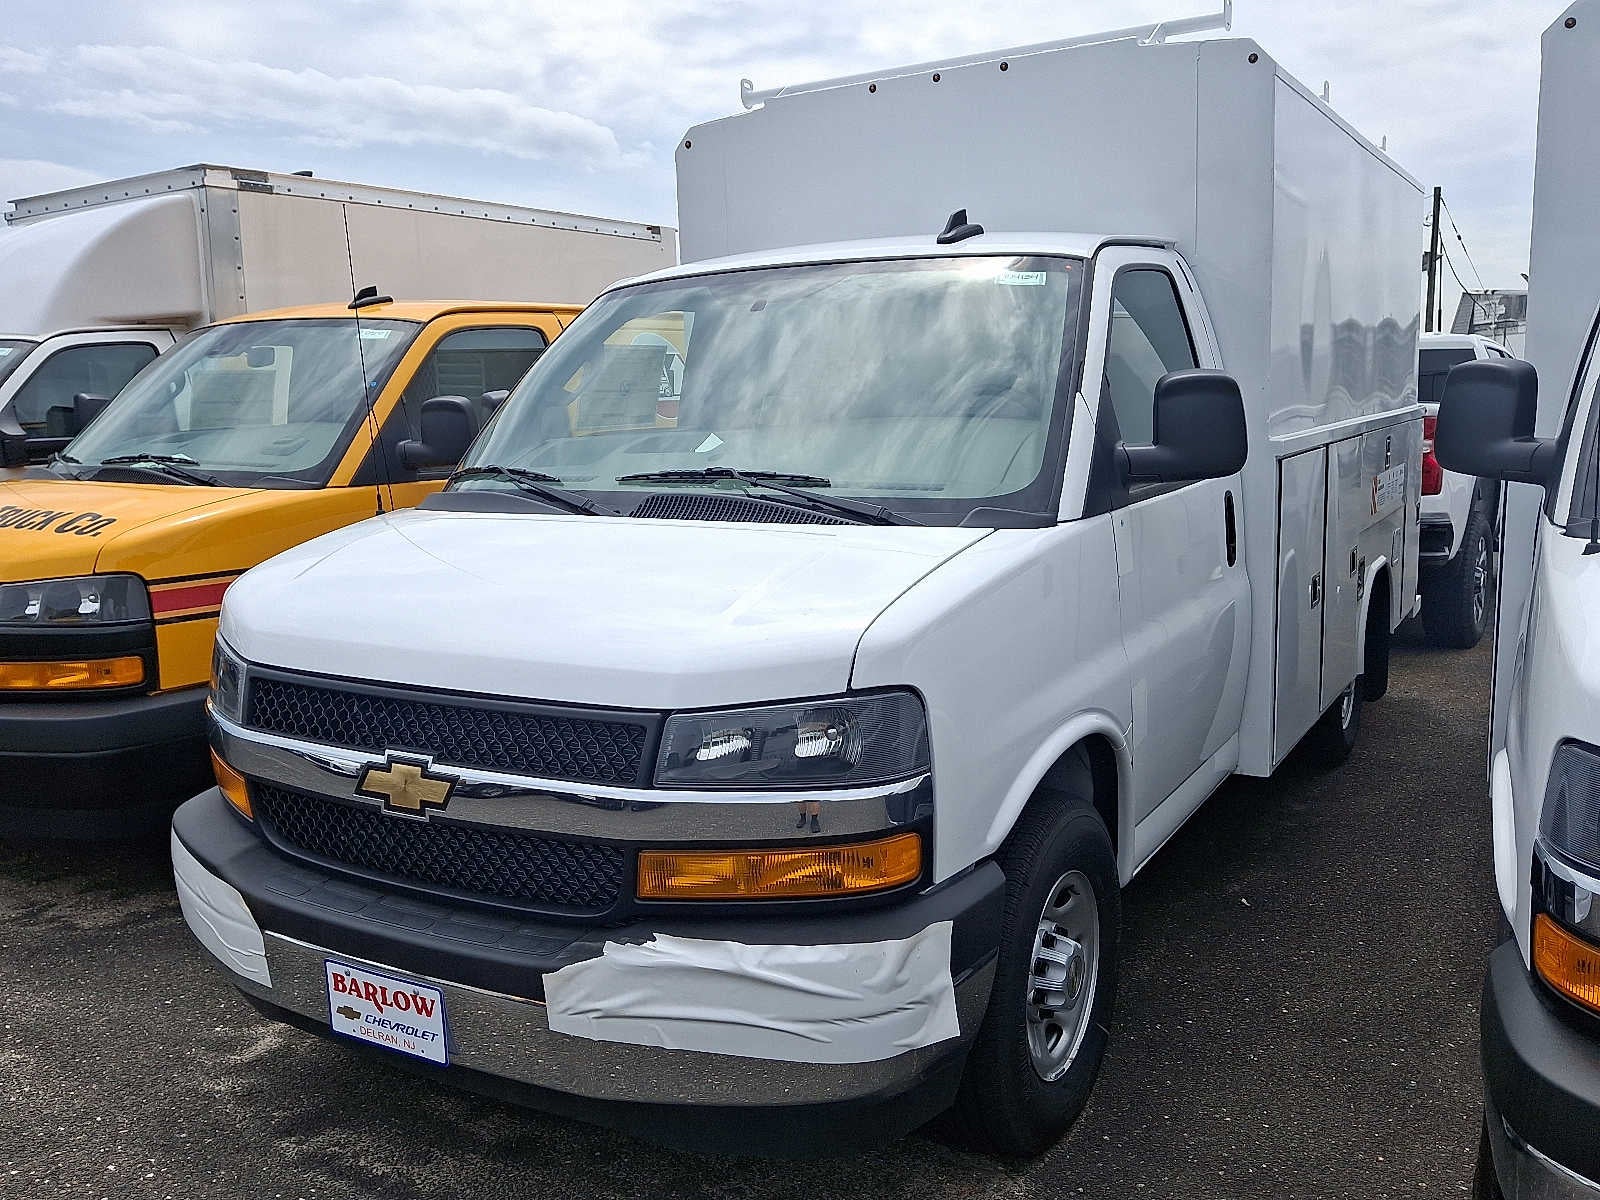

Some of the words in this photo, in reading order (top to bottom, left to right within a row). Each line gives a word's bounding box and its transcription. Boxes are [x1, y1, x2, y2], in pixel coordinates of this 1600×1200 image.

[0, 505, 74, 531] RUCK
[332, 972, 435, 1018] BARLOW
[359, 1025, 401, 1047] DELRAN,
[403, 1038, 416, 1050] NJ
[364, 1014, 439, 1042] CHEVROLET
